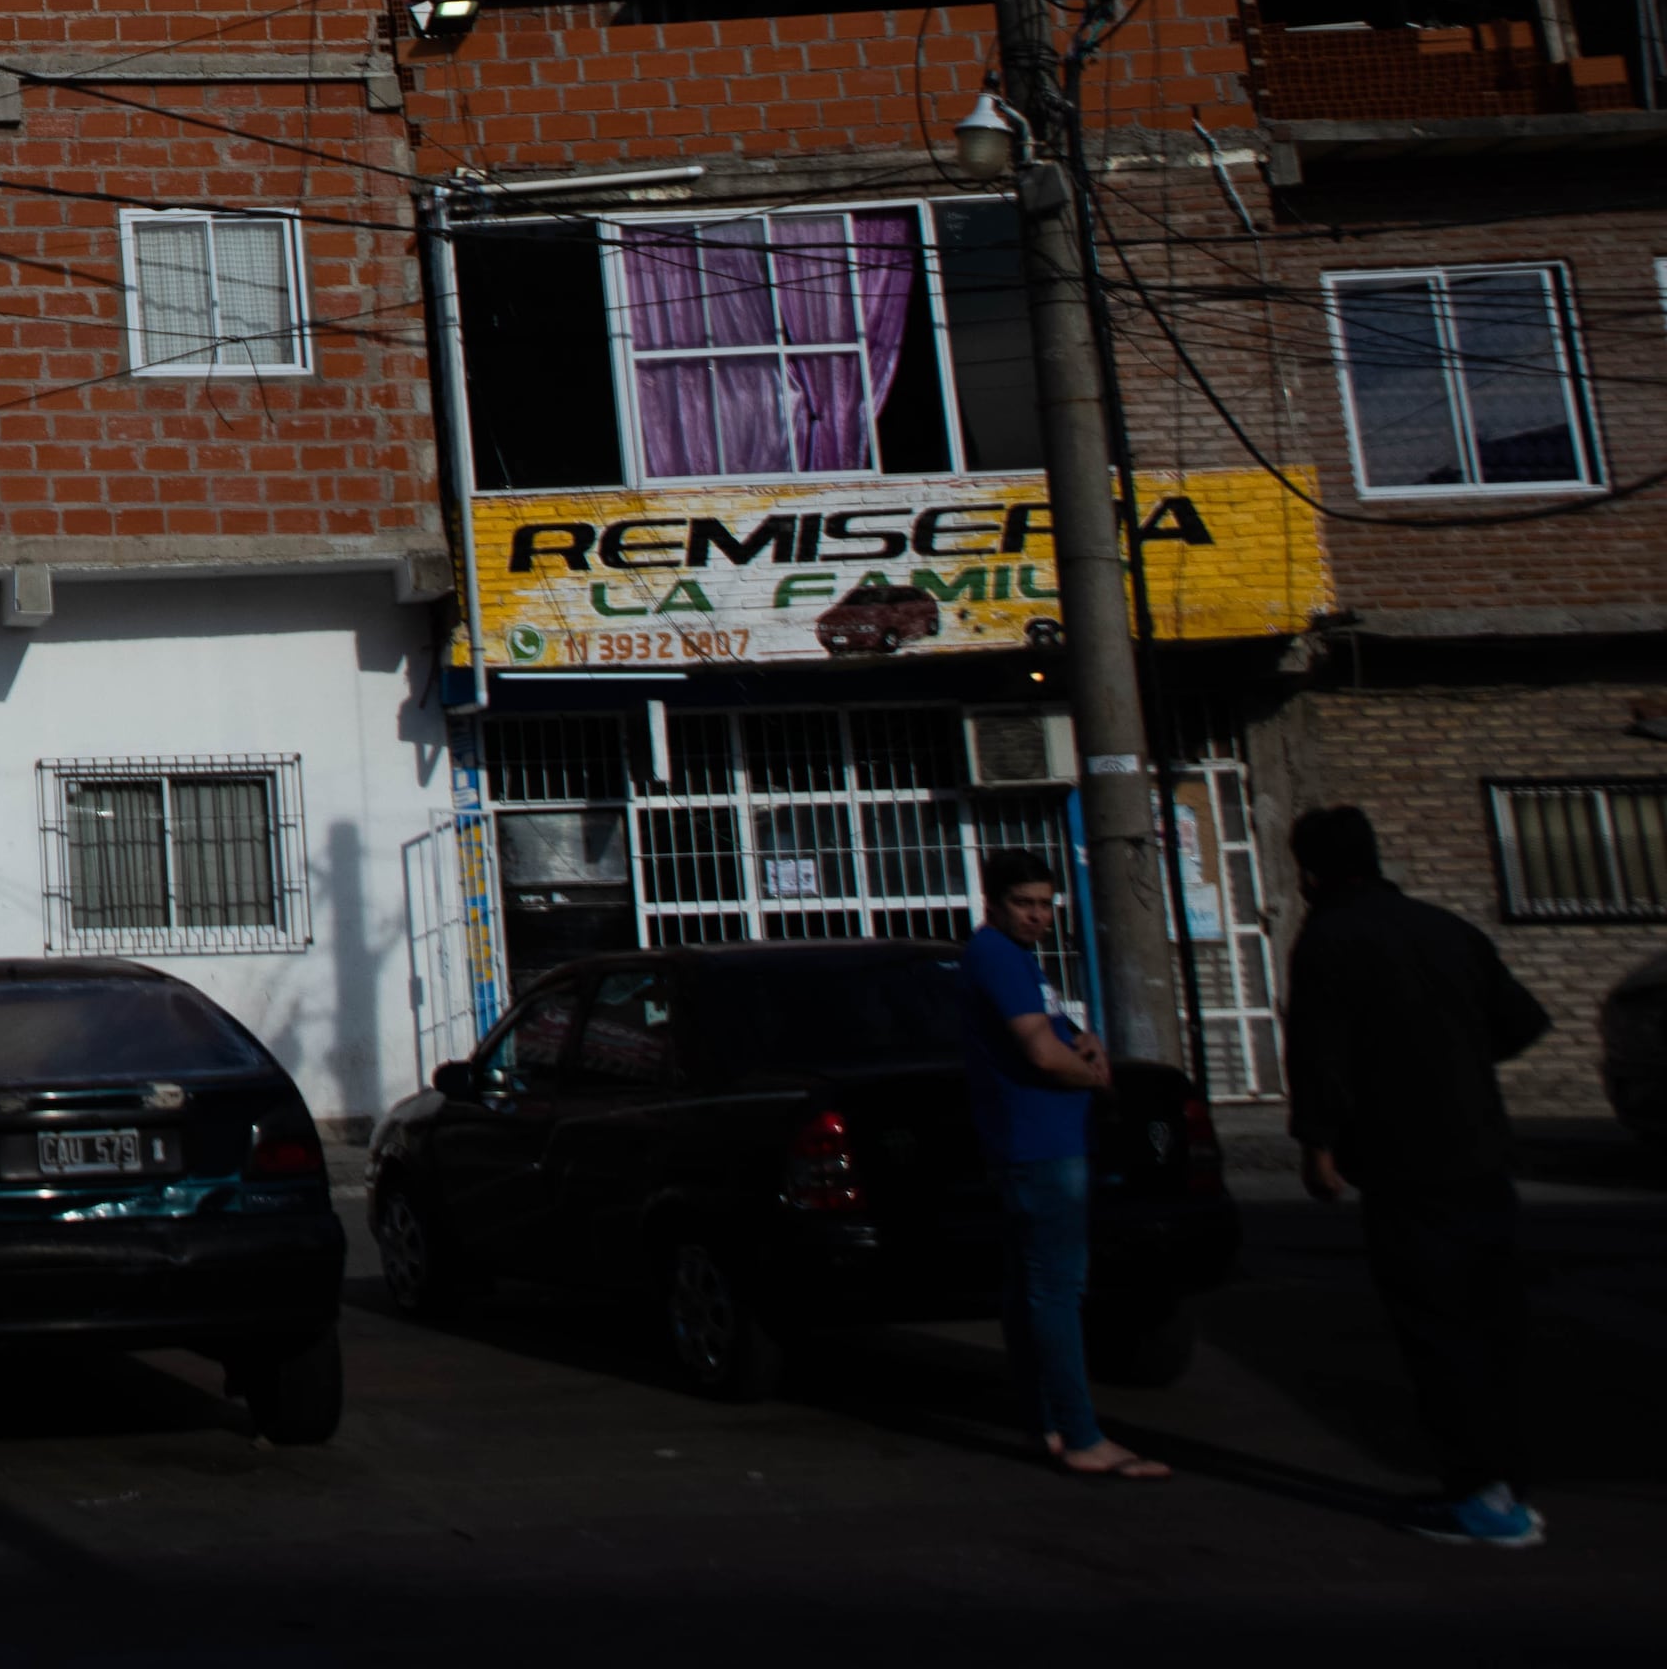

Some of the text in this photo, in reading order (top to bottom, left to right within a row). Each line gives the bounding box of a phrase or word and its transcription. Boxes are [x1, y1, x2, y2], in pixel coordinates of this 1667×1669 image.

[508, 496, 1214, 572] REMISERA
[590, 579, 714, 617] LA
[563, 631, 589, 663] 11
[681, 630, 750, 660] 6807
[94, 1135, 139, 1165] 579
